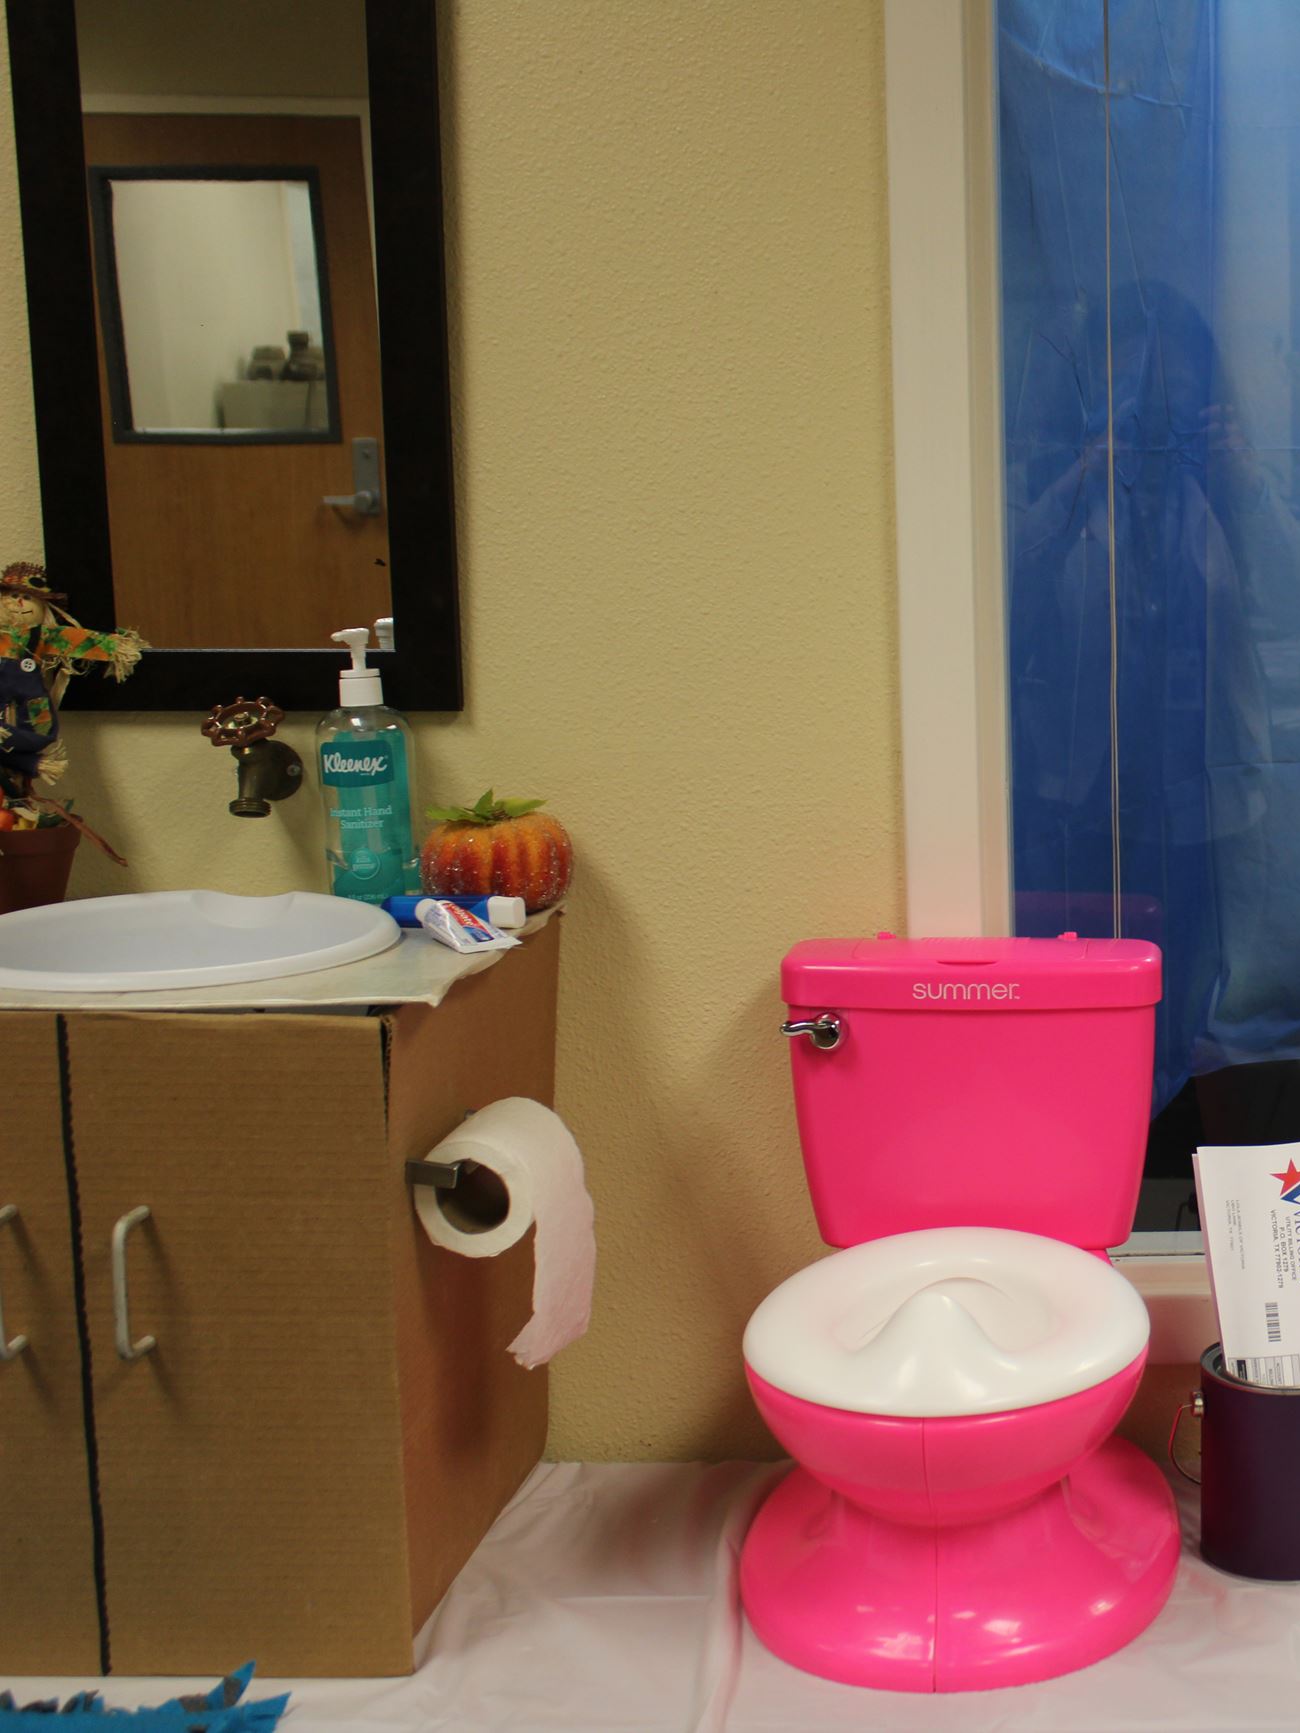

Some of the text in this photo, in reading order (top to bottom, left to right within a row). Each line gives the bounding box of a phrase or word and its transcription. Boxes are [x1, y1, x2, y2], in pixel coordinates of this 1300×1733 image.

[323, 752, 387, 776] Kleenex
[330, 805, 392, 817] Instant Hand
[341, 819, 384, 830] Sanitizer
[912, 983, 1020, 1000] summer
[1274, 1243, 1280, 1252] TX
